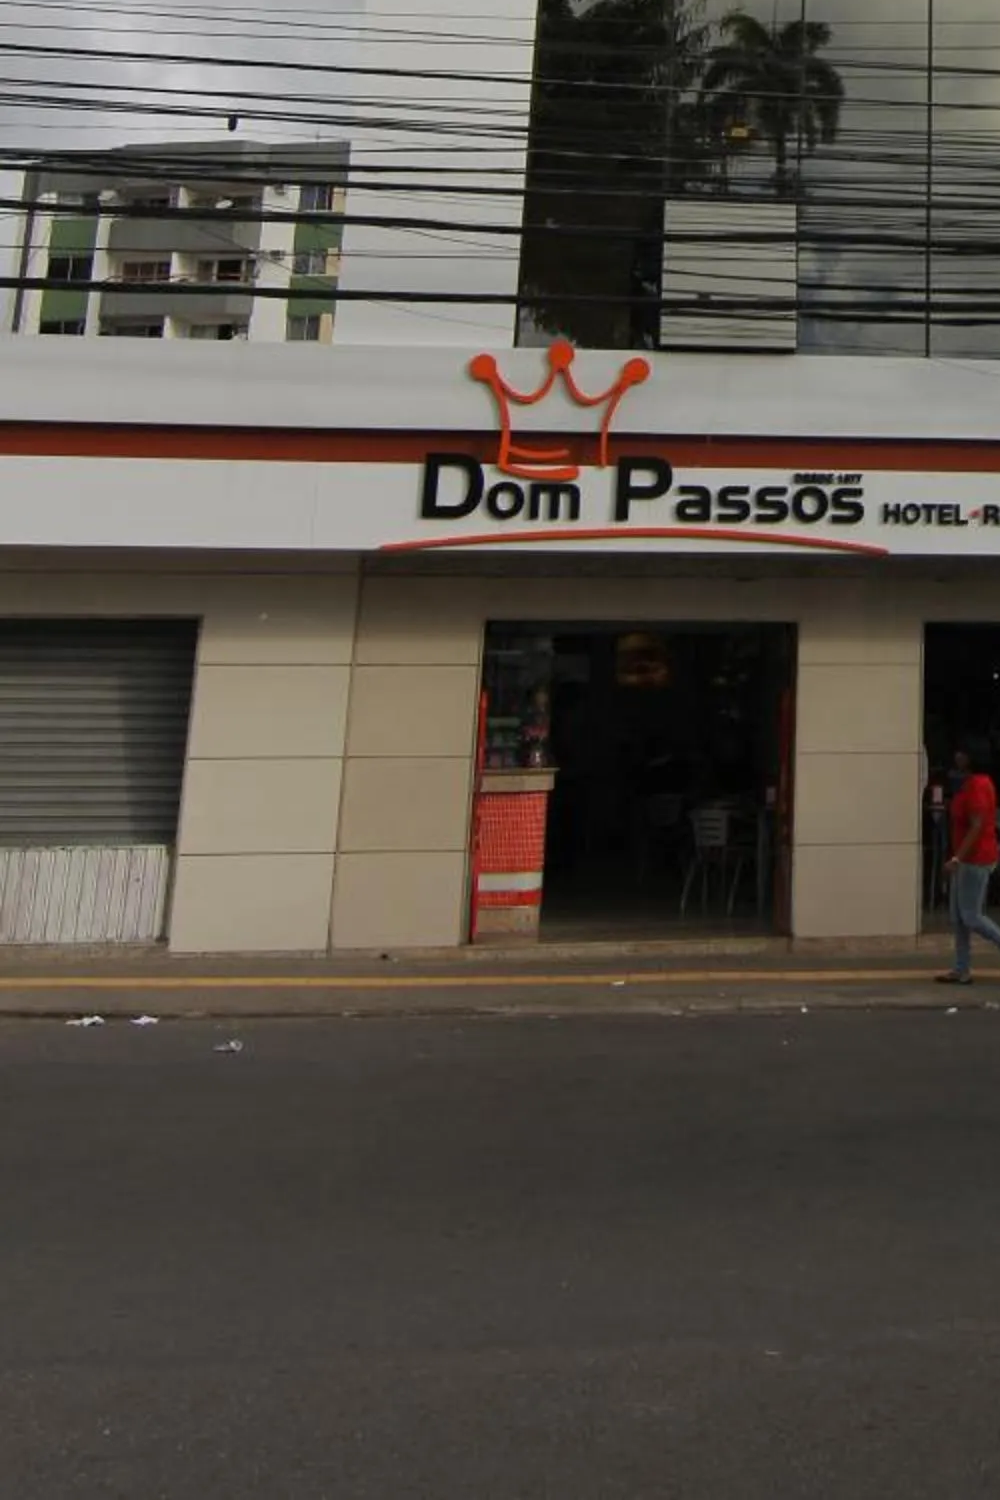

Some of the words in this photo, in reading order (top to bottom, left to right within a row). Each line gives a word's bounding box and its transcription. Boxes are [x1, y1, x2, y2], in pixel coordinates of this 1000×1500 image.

[420, 452, 580, 520] Dom
[615, 455, 865, 525] Passos
[883, 503, 968, 526] HOTEL
